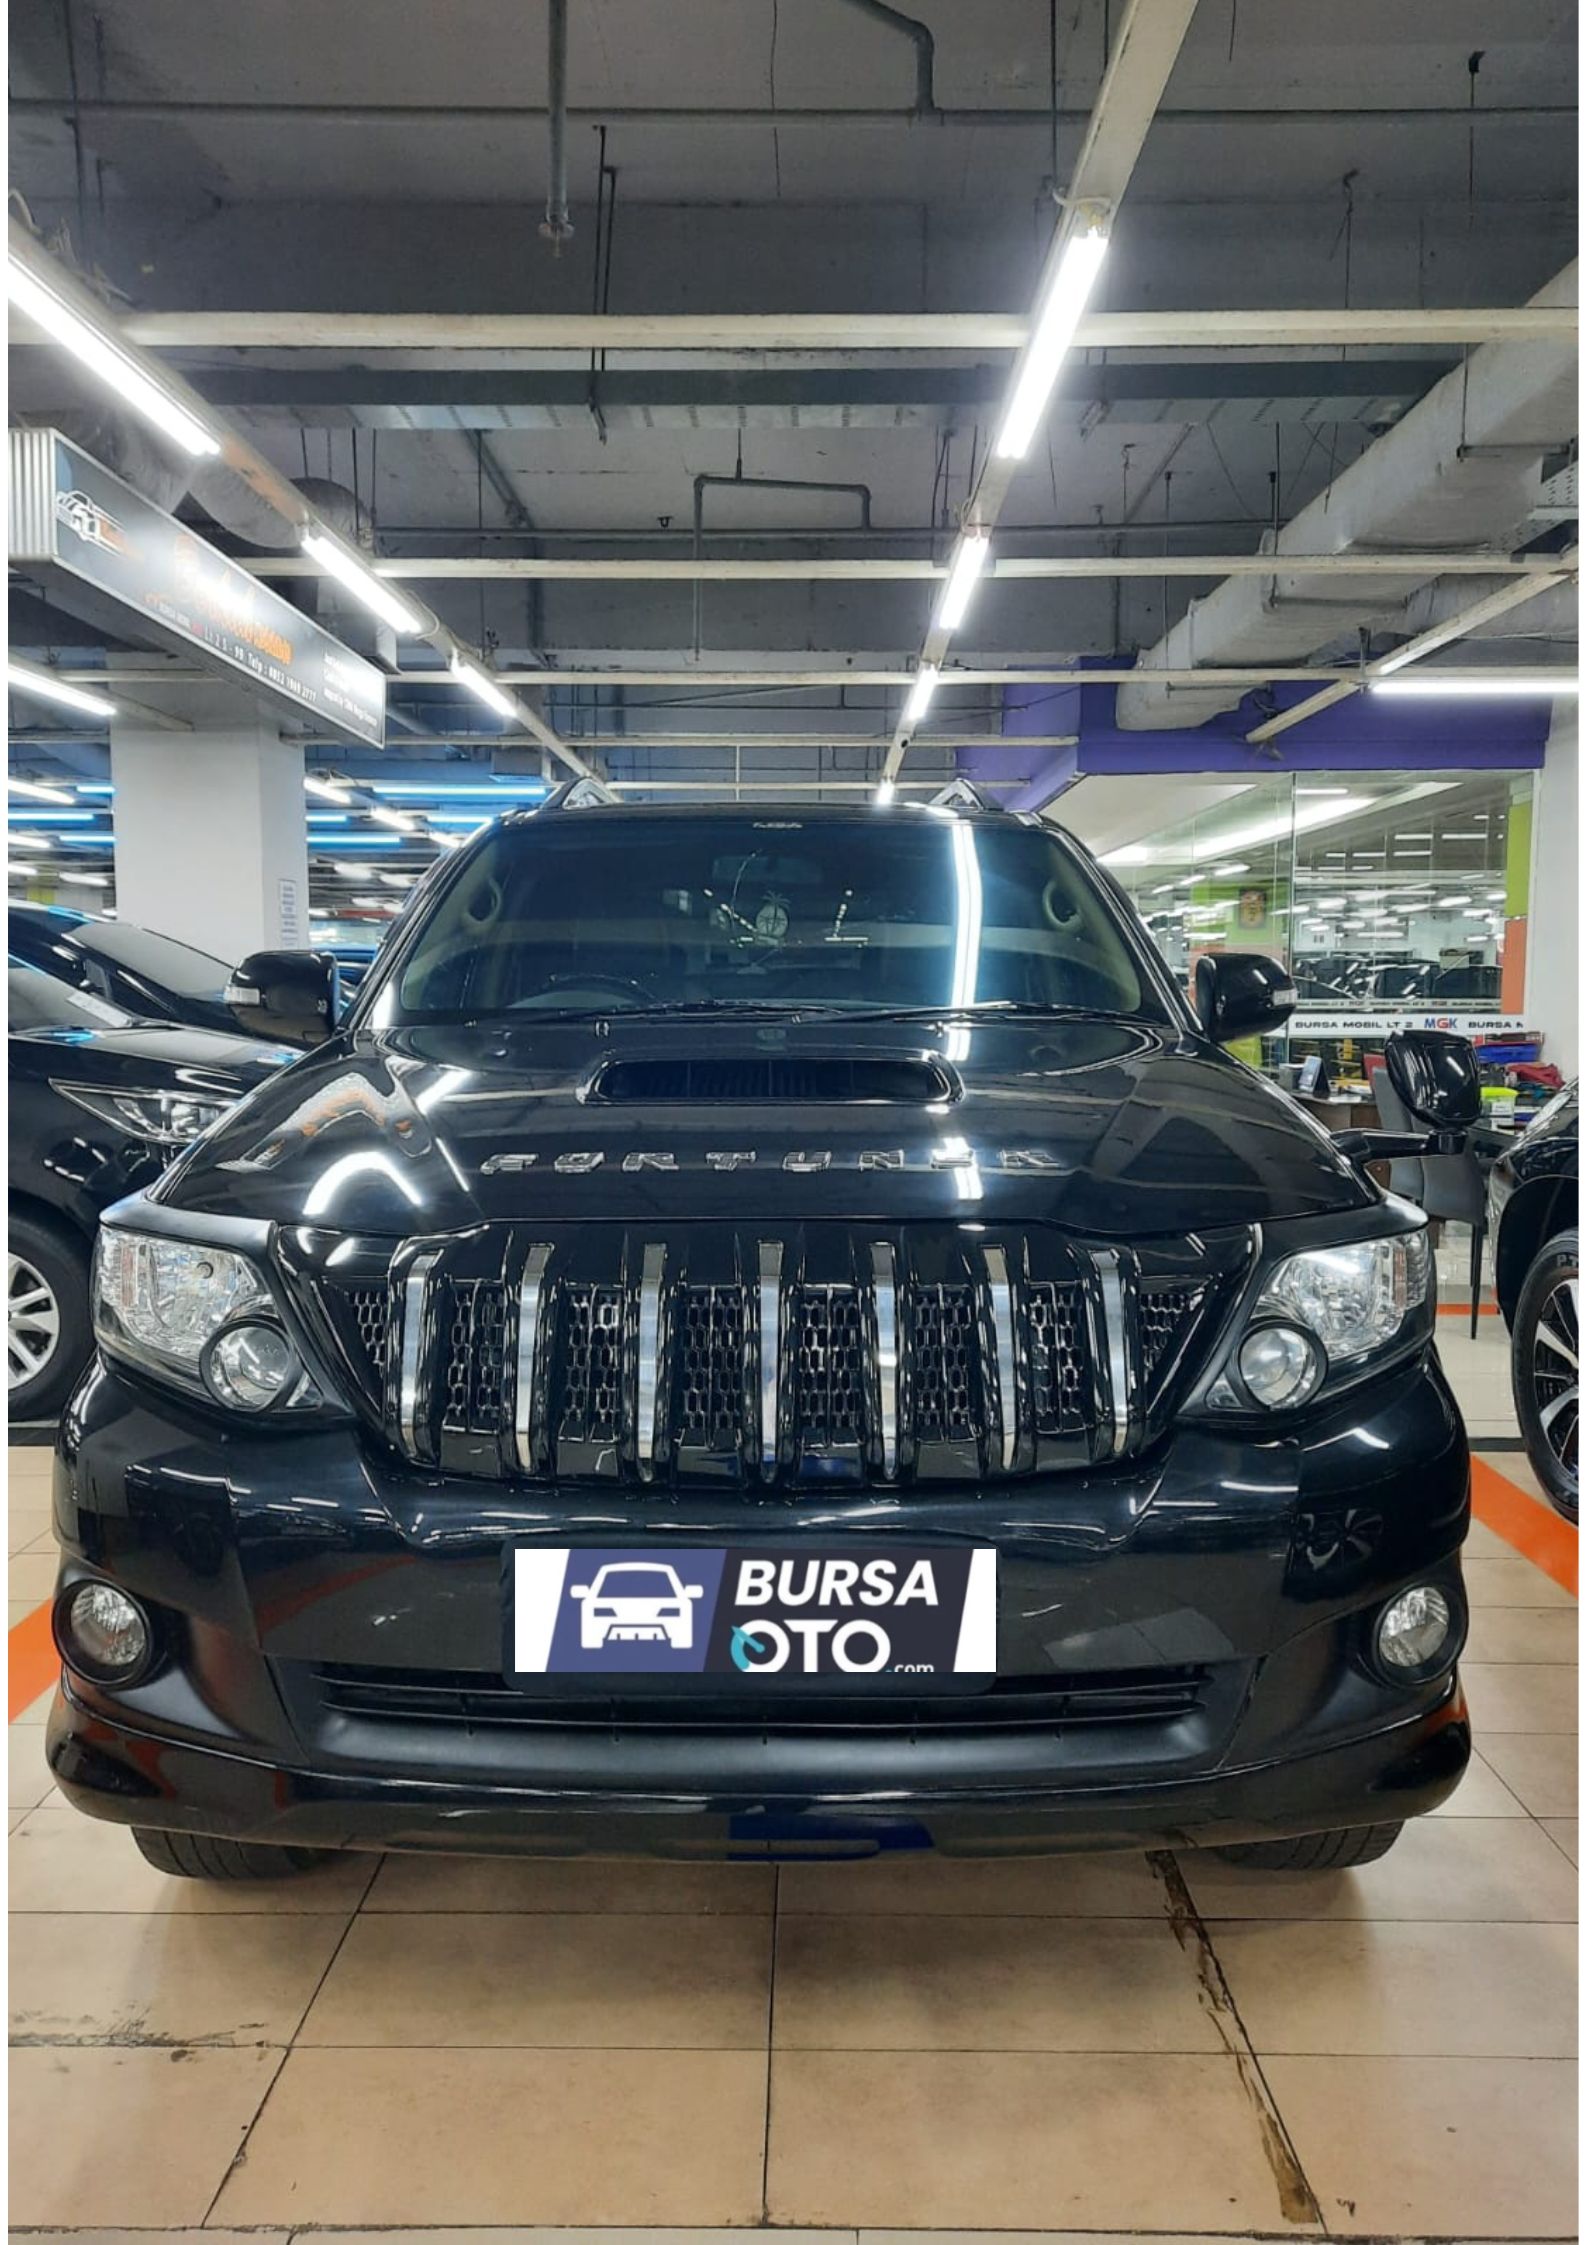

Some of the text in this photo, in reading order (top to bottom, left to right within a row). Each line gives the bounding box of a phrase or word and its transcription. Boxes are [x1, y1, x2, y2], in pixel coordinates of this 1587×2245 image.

[1295, 1021, 1338, 1029] BURSA
[1343, 1021, 1382, 1029] MOBIL
[1387, 1021, 1400, 1029] LT
[1405, 1021, 1413, 1029] 2
[1424, 1017, 1458, 1029] MGK
[1468, 1021, 1512, 1029] BURSA
